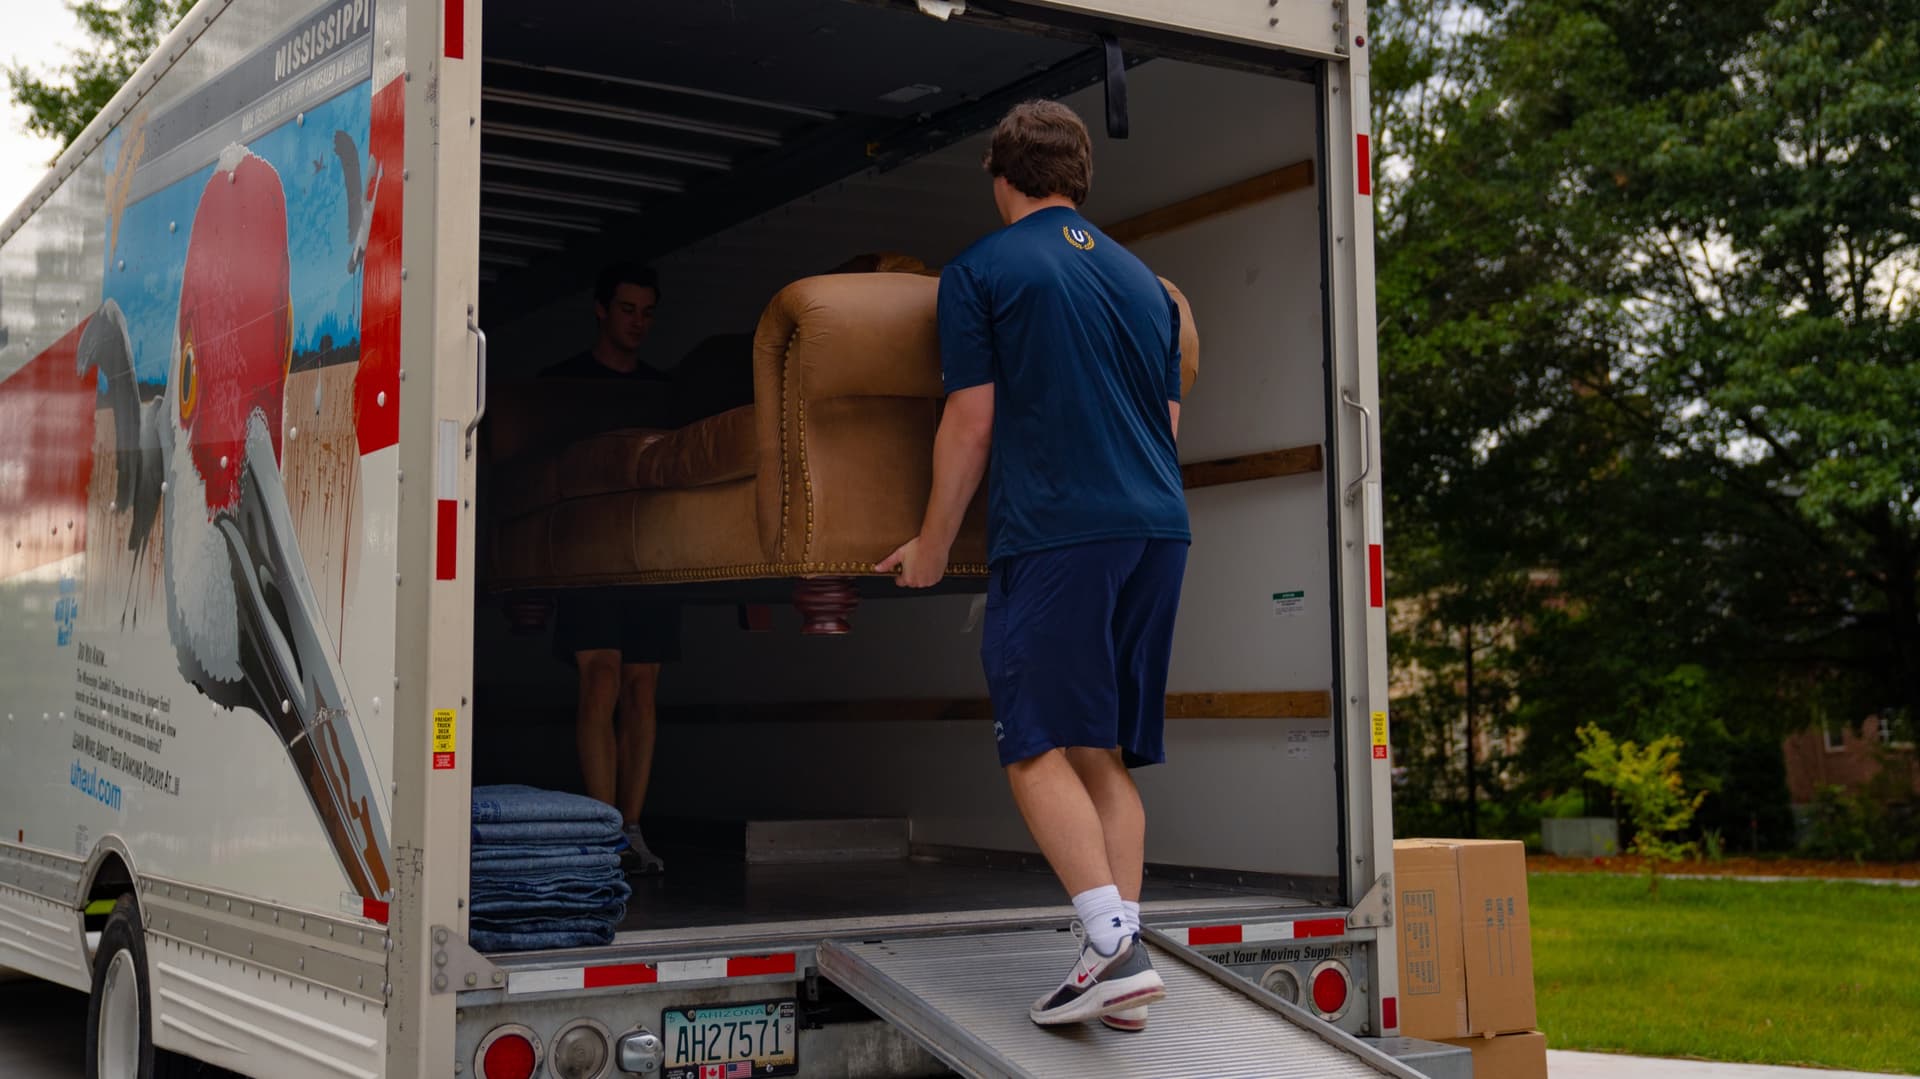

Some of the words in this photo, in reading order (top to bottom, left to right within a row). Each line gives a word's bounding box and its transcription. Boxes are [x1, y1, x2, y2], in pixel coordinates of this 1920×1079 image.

[274, 0, 369, 81] MISSISSIPPI
[82, 671, 97, 689] Mississippi
[98, 675, 111, 692] Sandhill
[111, 680, 120, 696] Crane
[70, 759, 121, 811] uhaul.com
[1207, 951, 1229, 964] rget
[1233, 950, 1257, 964] Your
[1260, 947, 1300, 962] Moving
[698, 1008, 764, 1019] ARIZONA
[676, 1019, 784, 1063] AH27571
